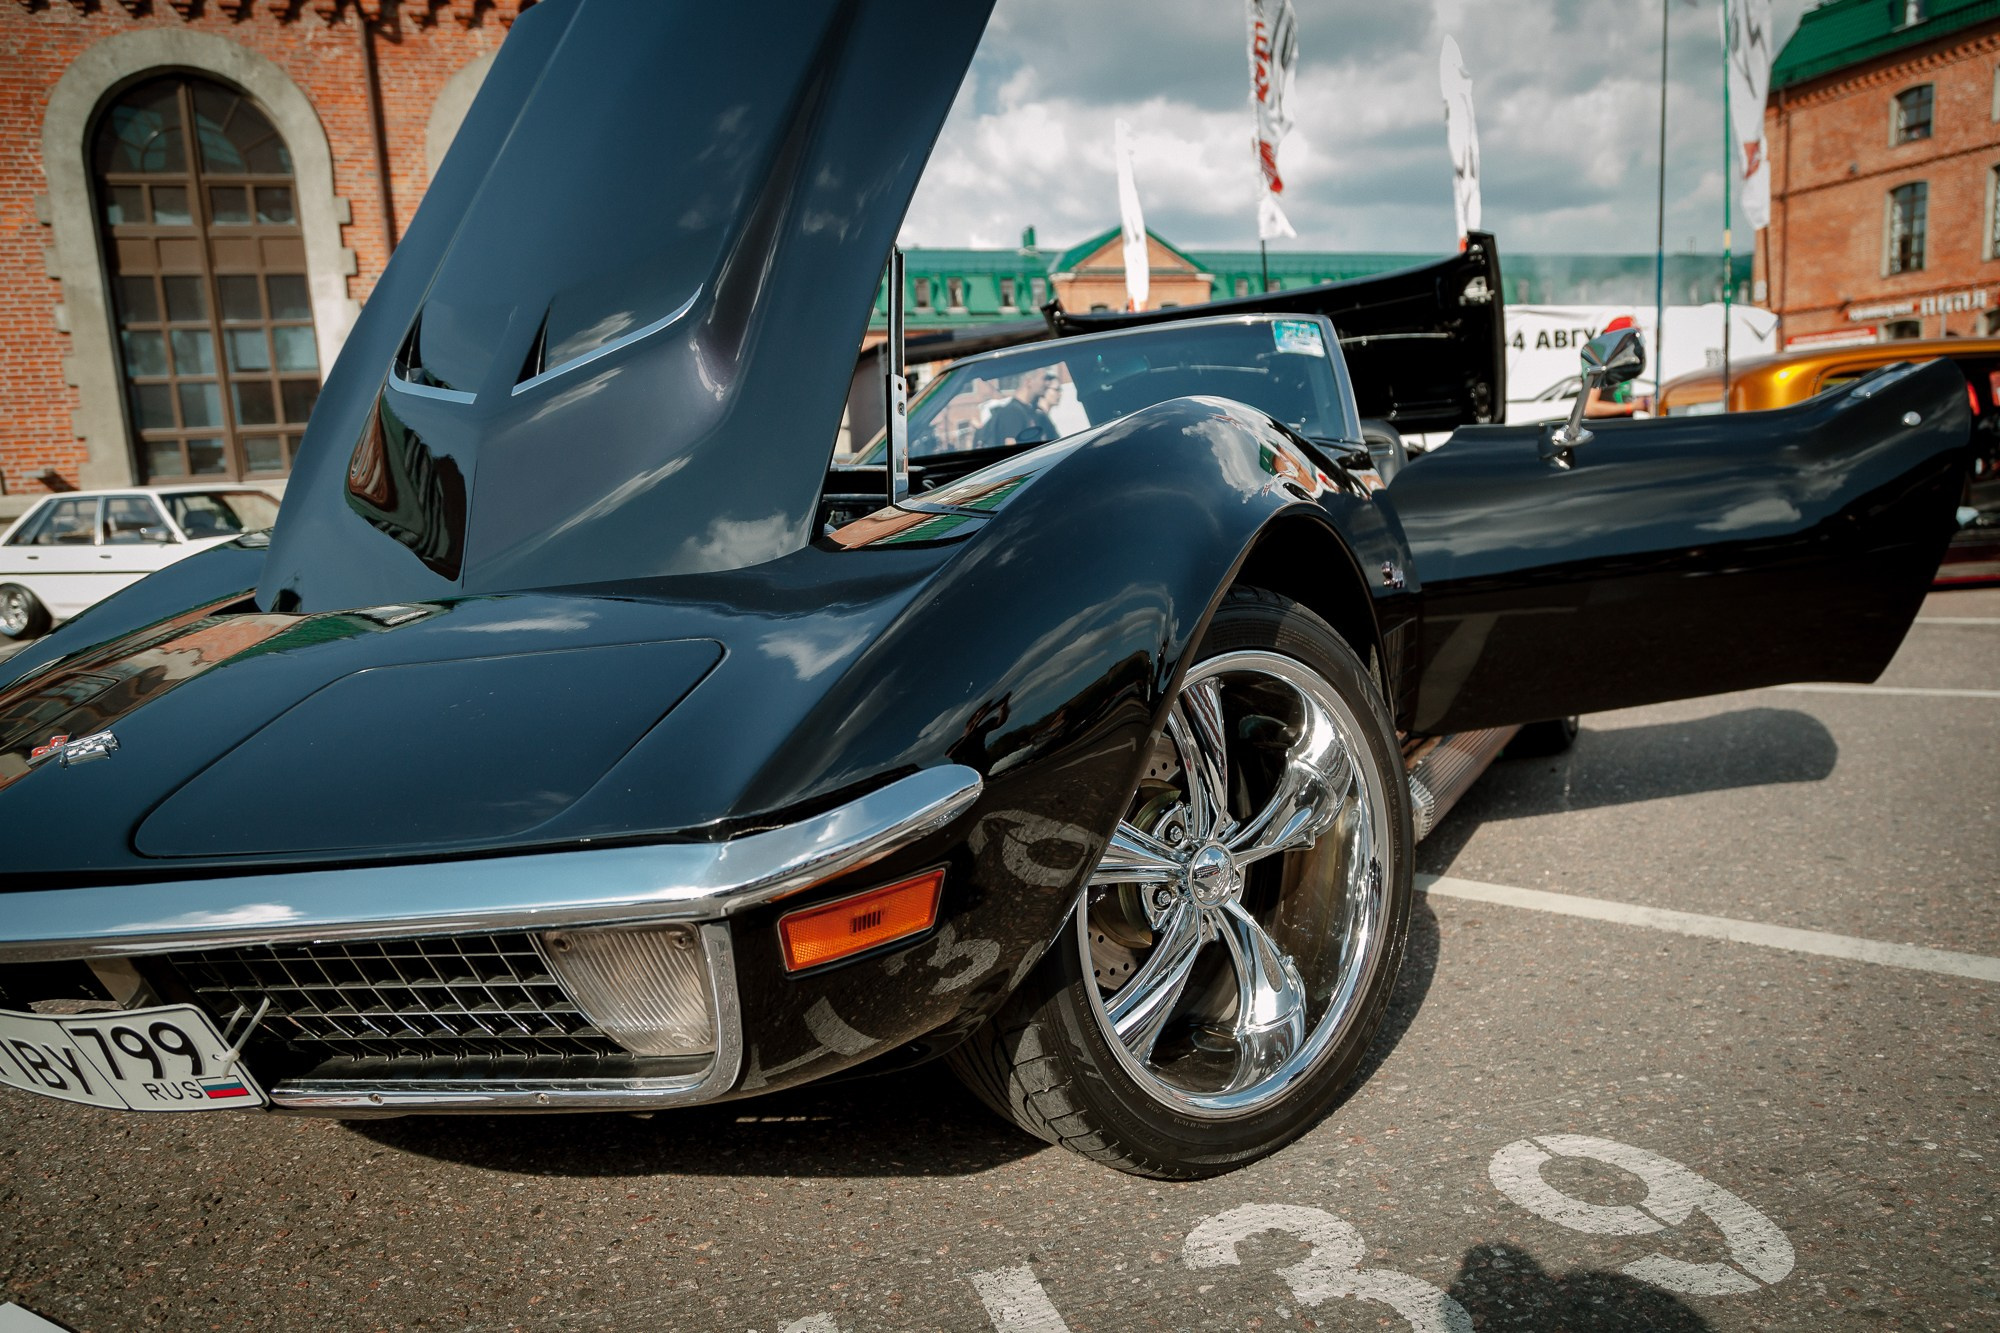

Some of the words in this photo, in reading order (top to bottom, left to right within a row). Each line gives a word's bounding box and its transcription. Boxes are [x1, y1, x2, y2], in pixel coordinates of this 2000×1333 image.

[1535, 327, 1597, 350] АВГУ
[69, 1021, 204, 1080] 799
[142, 1082, 203, 1101] RUS
